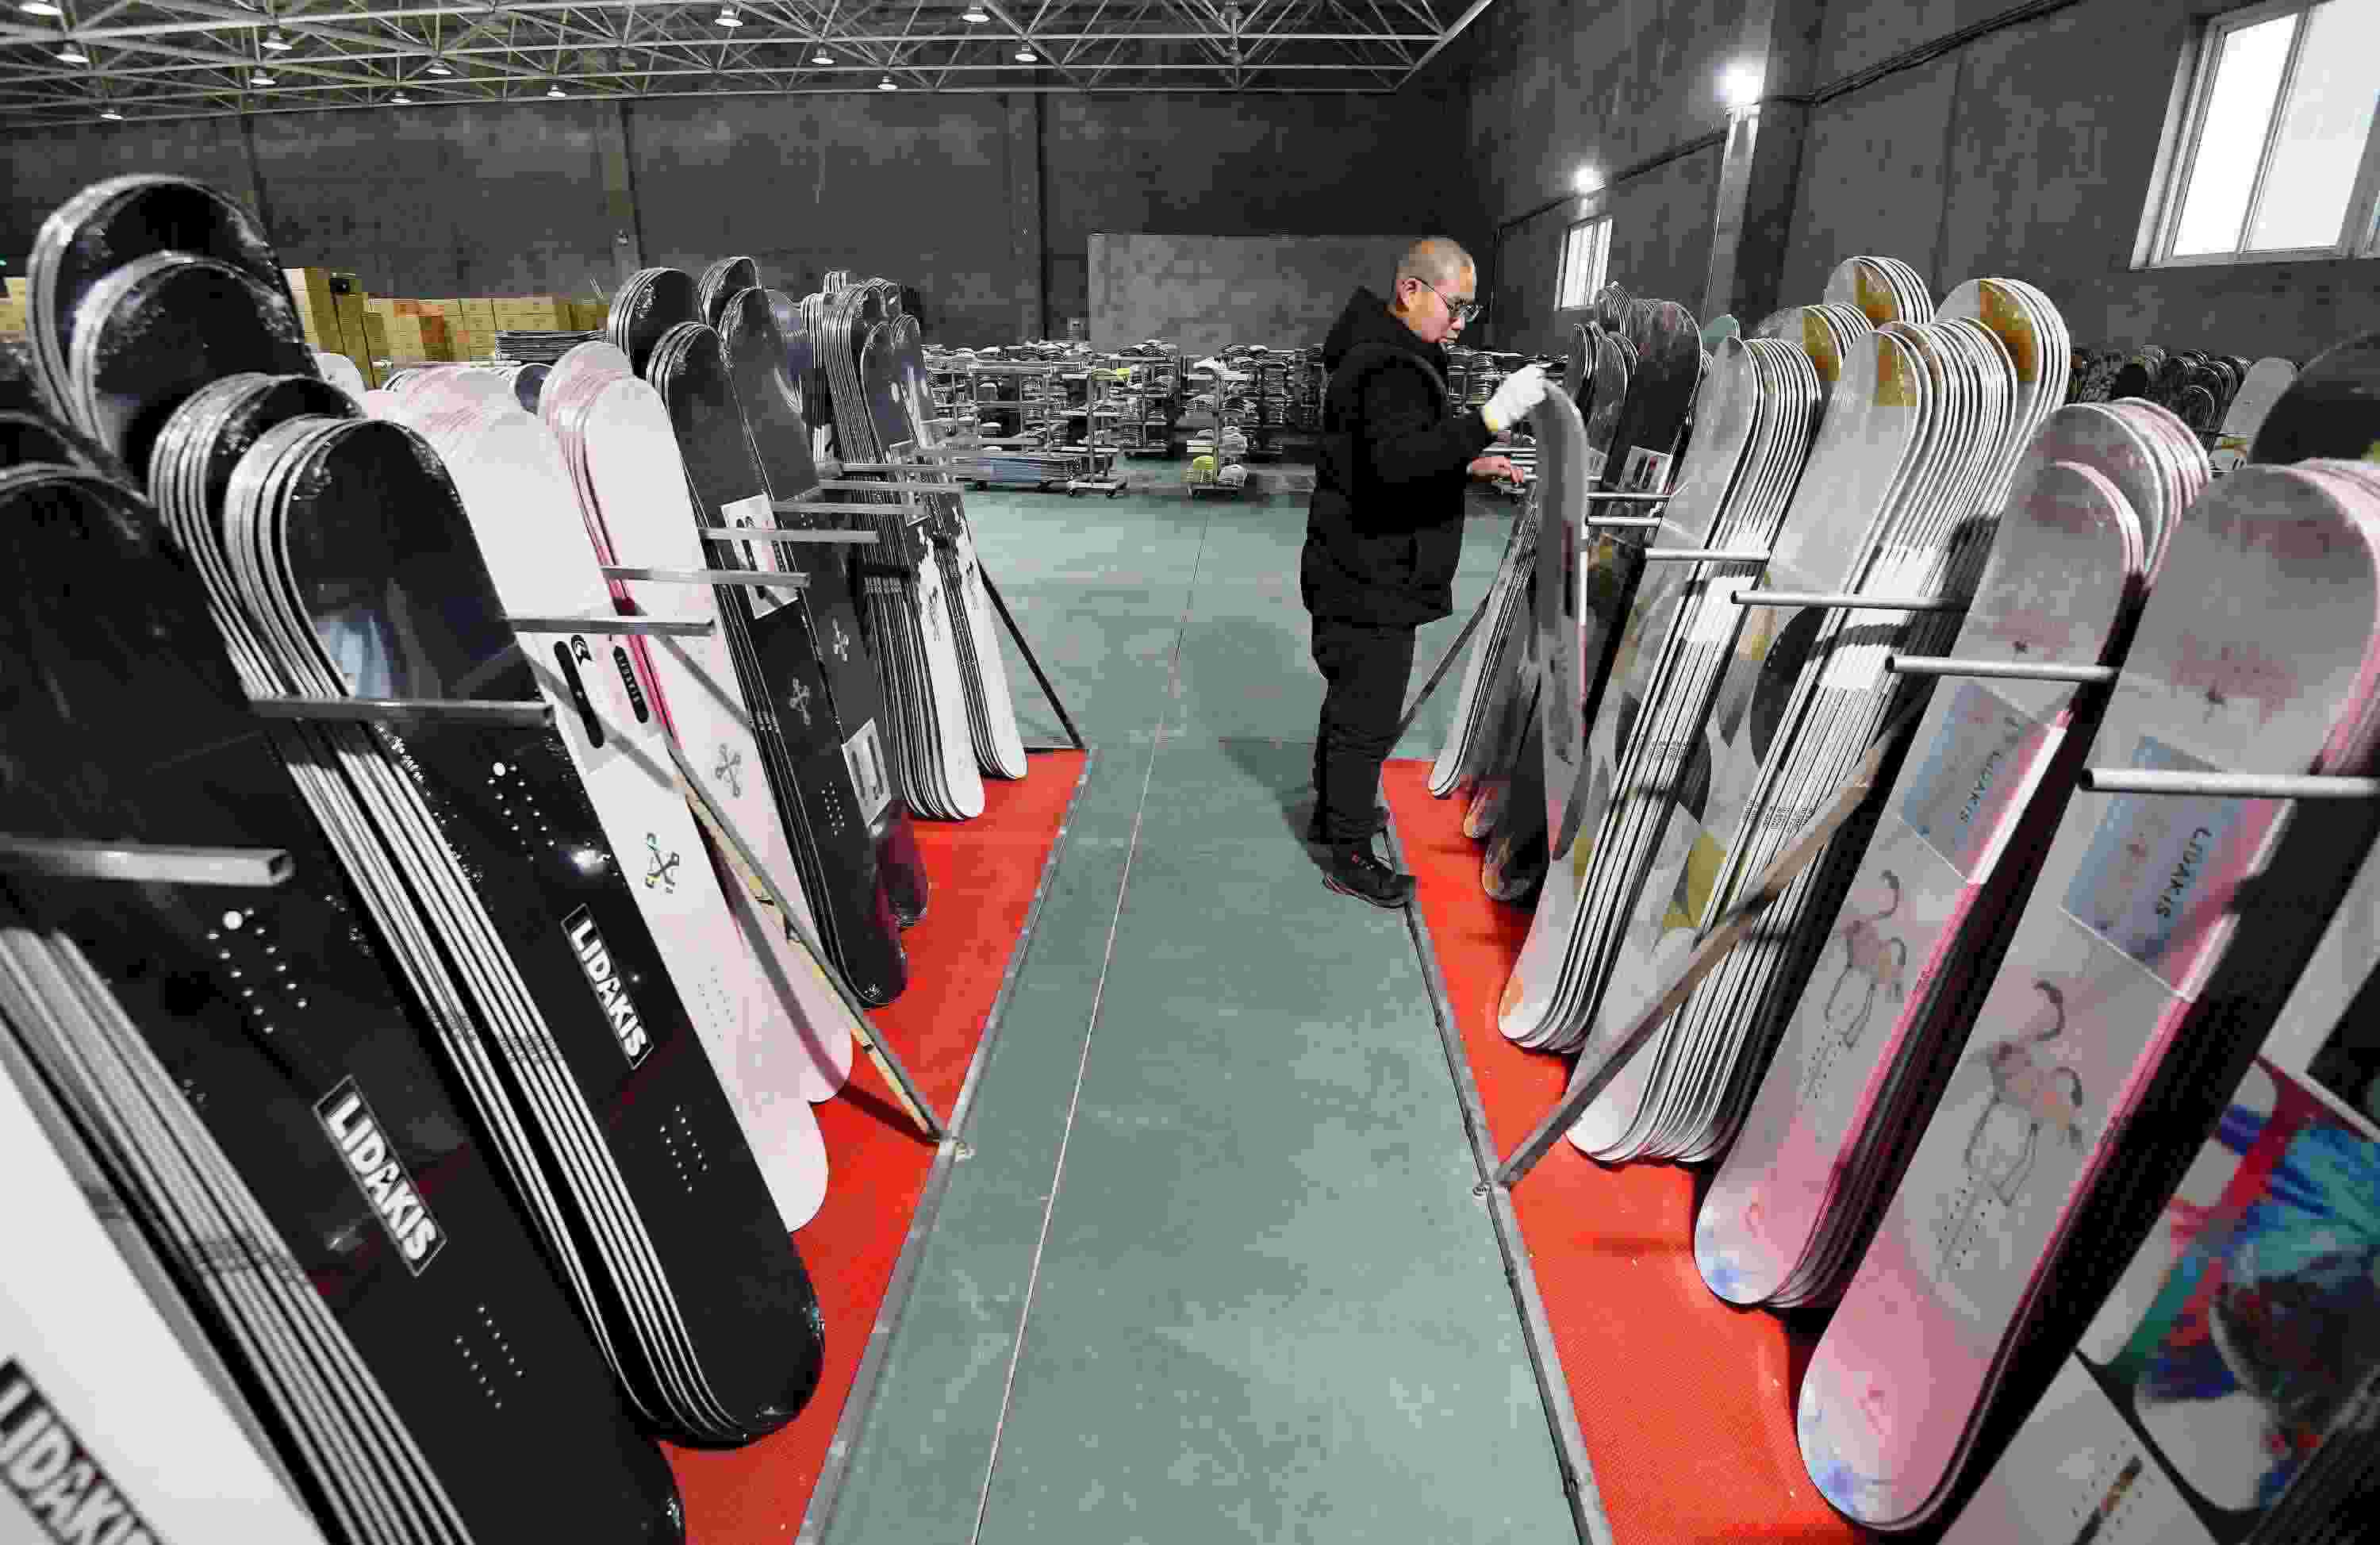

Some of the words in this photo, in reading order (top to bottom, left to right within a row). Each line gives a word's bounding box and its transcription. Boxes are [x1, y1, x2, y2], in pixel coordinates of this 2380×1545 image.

[2155, 825, 2213, 919] LIDAKIS
[570, 920, 647, 1056] LIDAKIS
[327, 1093, 436, 1259] LIDAKIS
[0, 1378, 163, 1545] IDAKI
